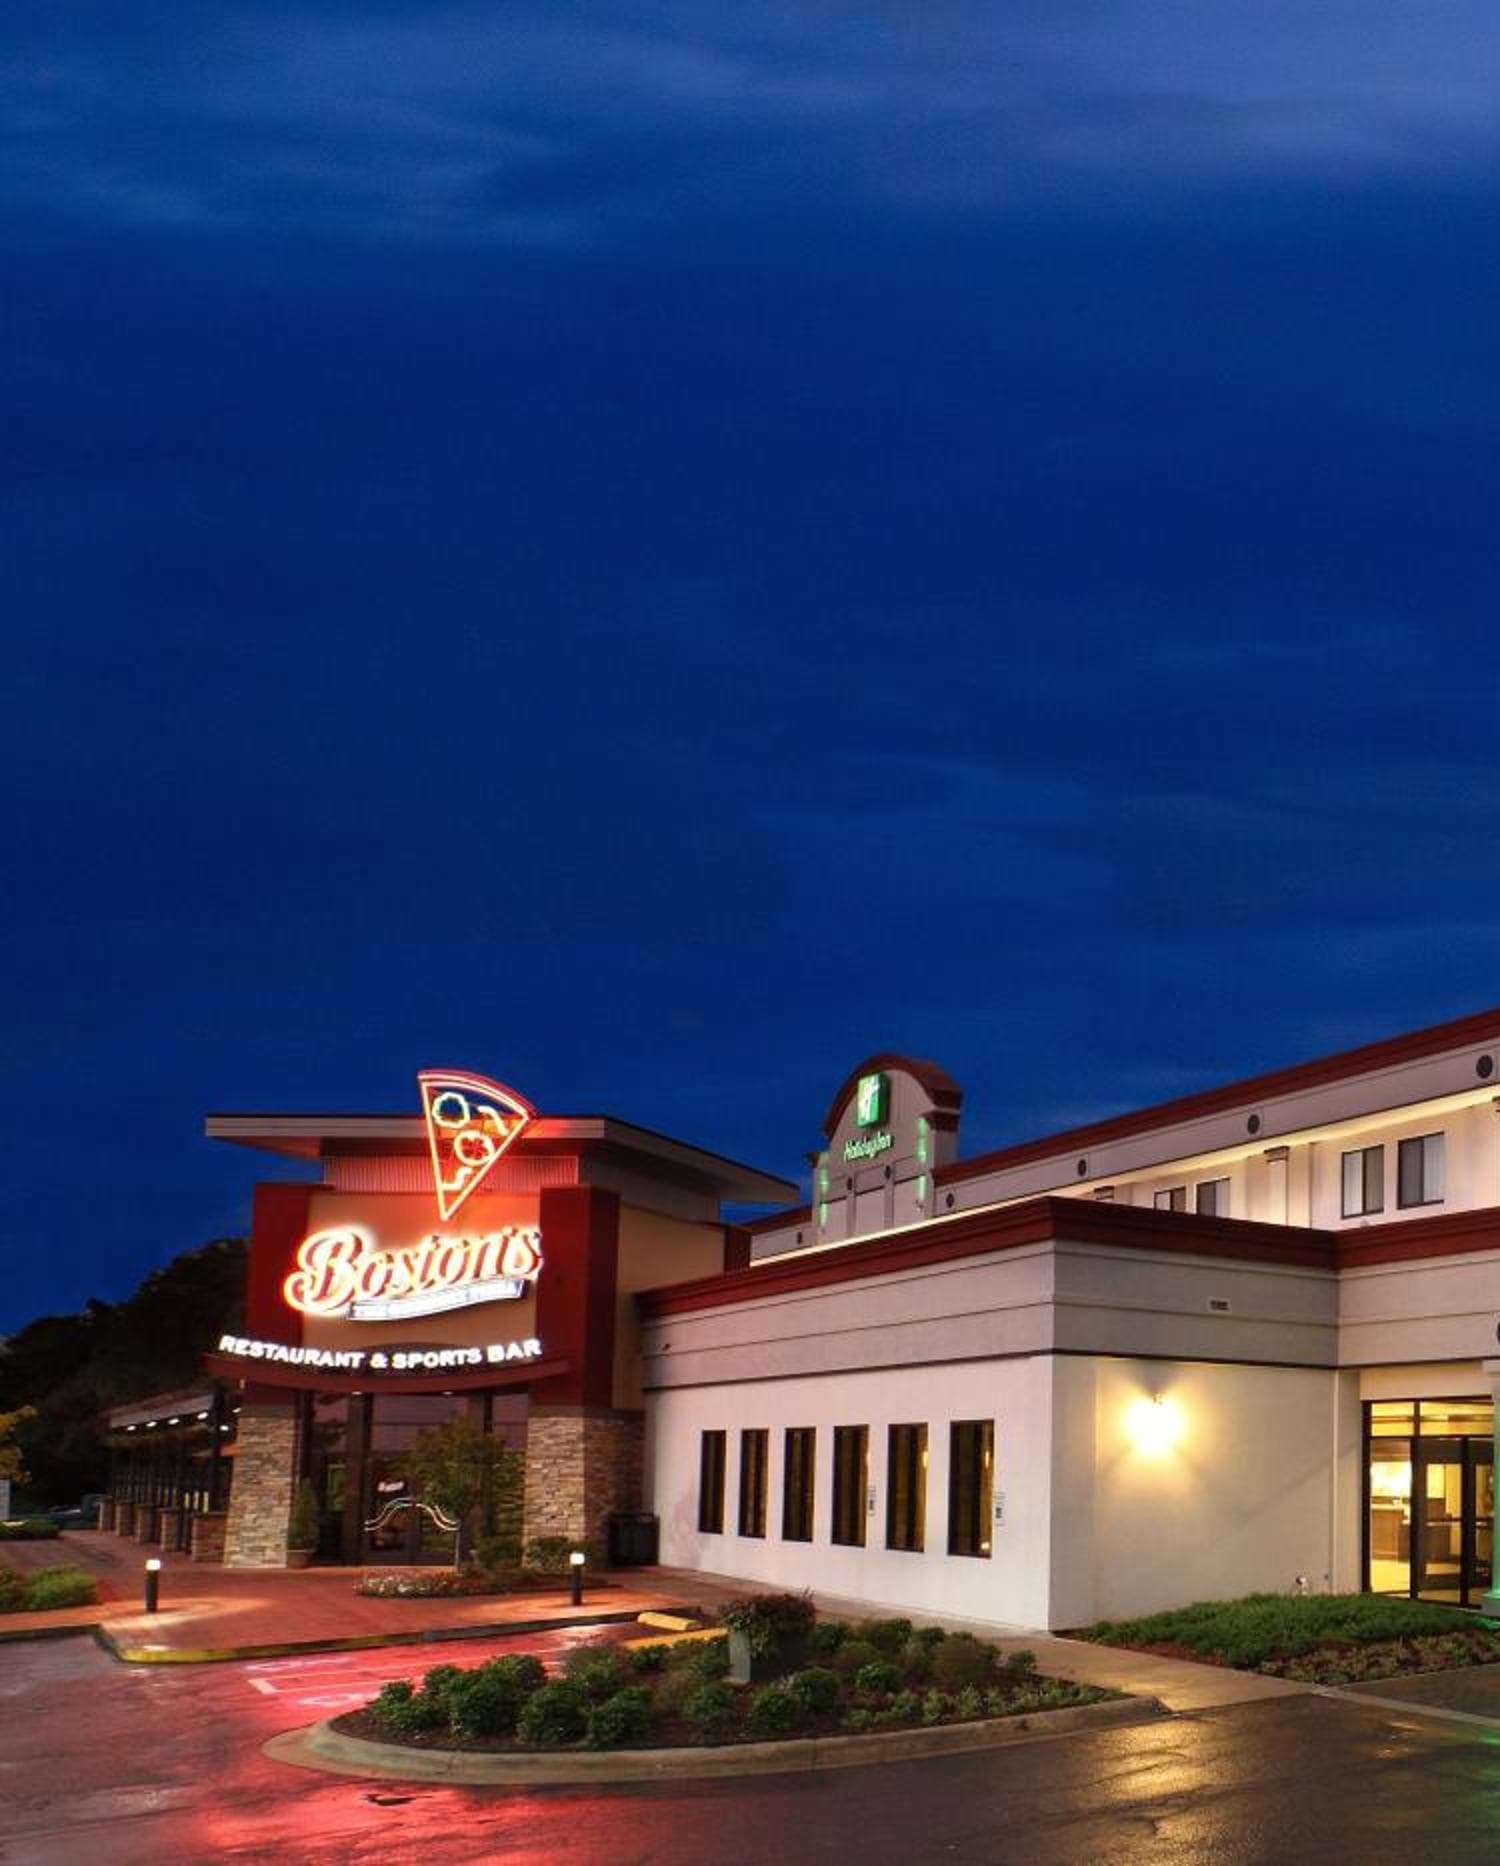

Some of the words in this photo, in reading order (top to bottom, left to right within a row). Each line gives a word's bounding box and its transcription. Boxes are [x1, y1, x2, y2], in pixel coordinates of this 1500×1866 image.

[284, 1226, 544, 1316] Boston's
[218, 1335, 365, 1369] RESTAURANT
[370, 1351, 388, 1369] &
[392, 1348, 482, 1369] SPORTS
[487, 1338, 542, 1363] BAR
